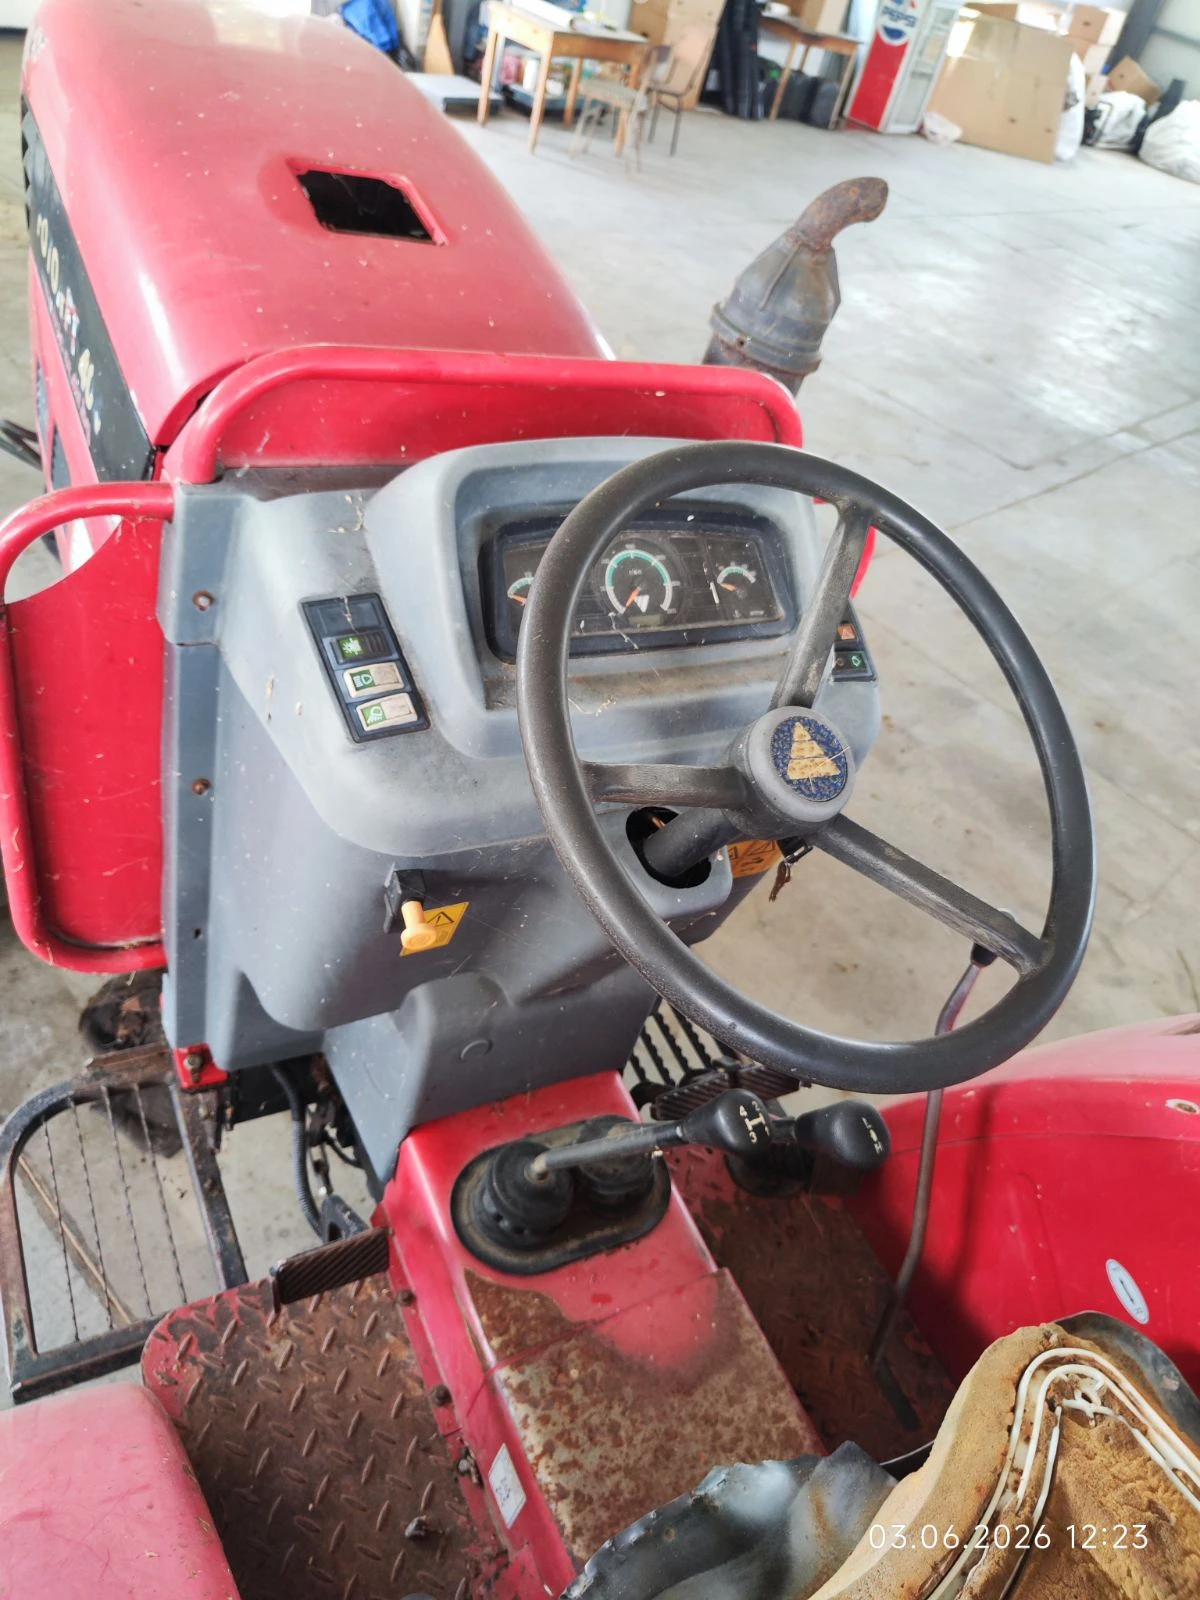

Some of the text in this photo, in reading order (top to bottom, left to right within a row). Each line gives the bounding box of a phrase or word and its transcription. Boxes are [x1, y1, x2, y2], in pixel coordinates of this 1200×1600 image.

[739, 1100, 761, 1117] 4 2
[749, 1132, 757, 1144] 3
